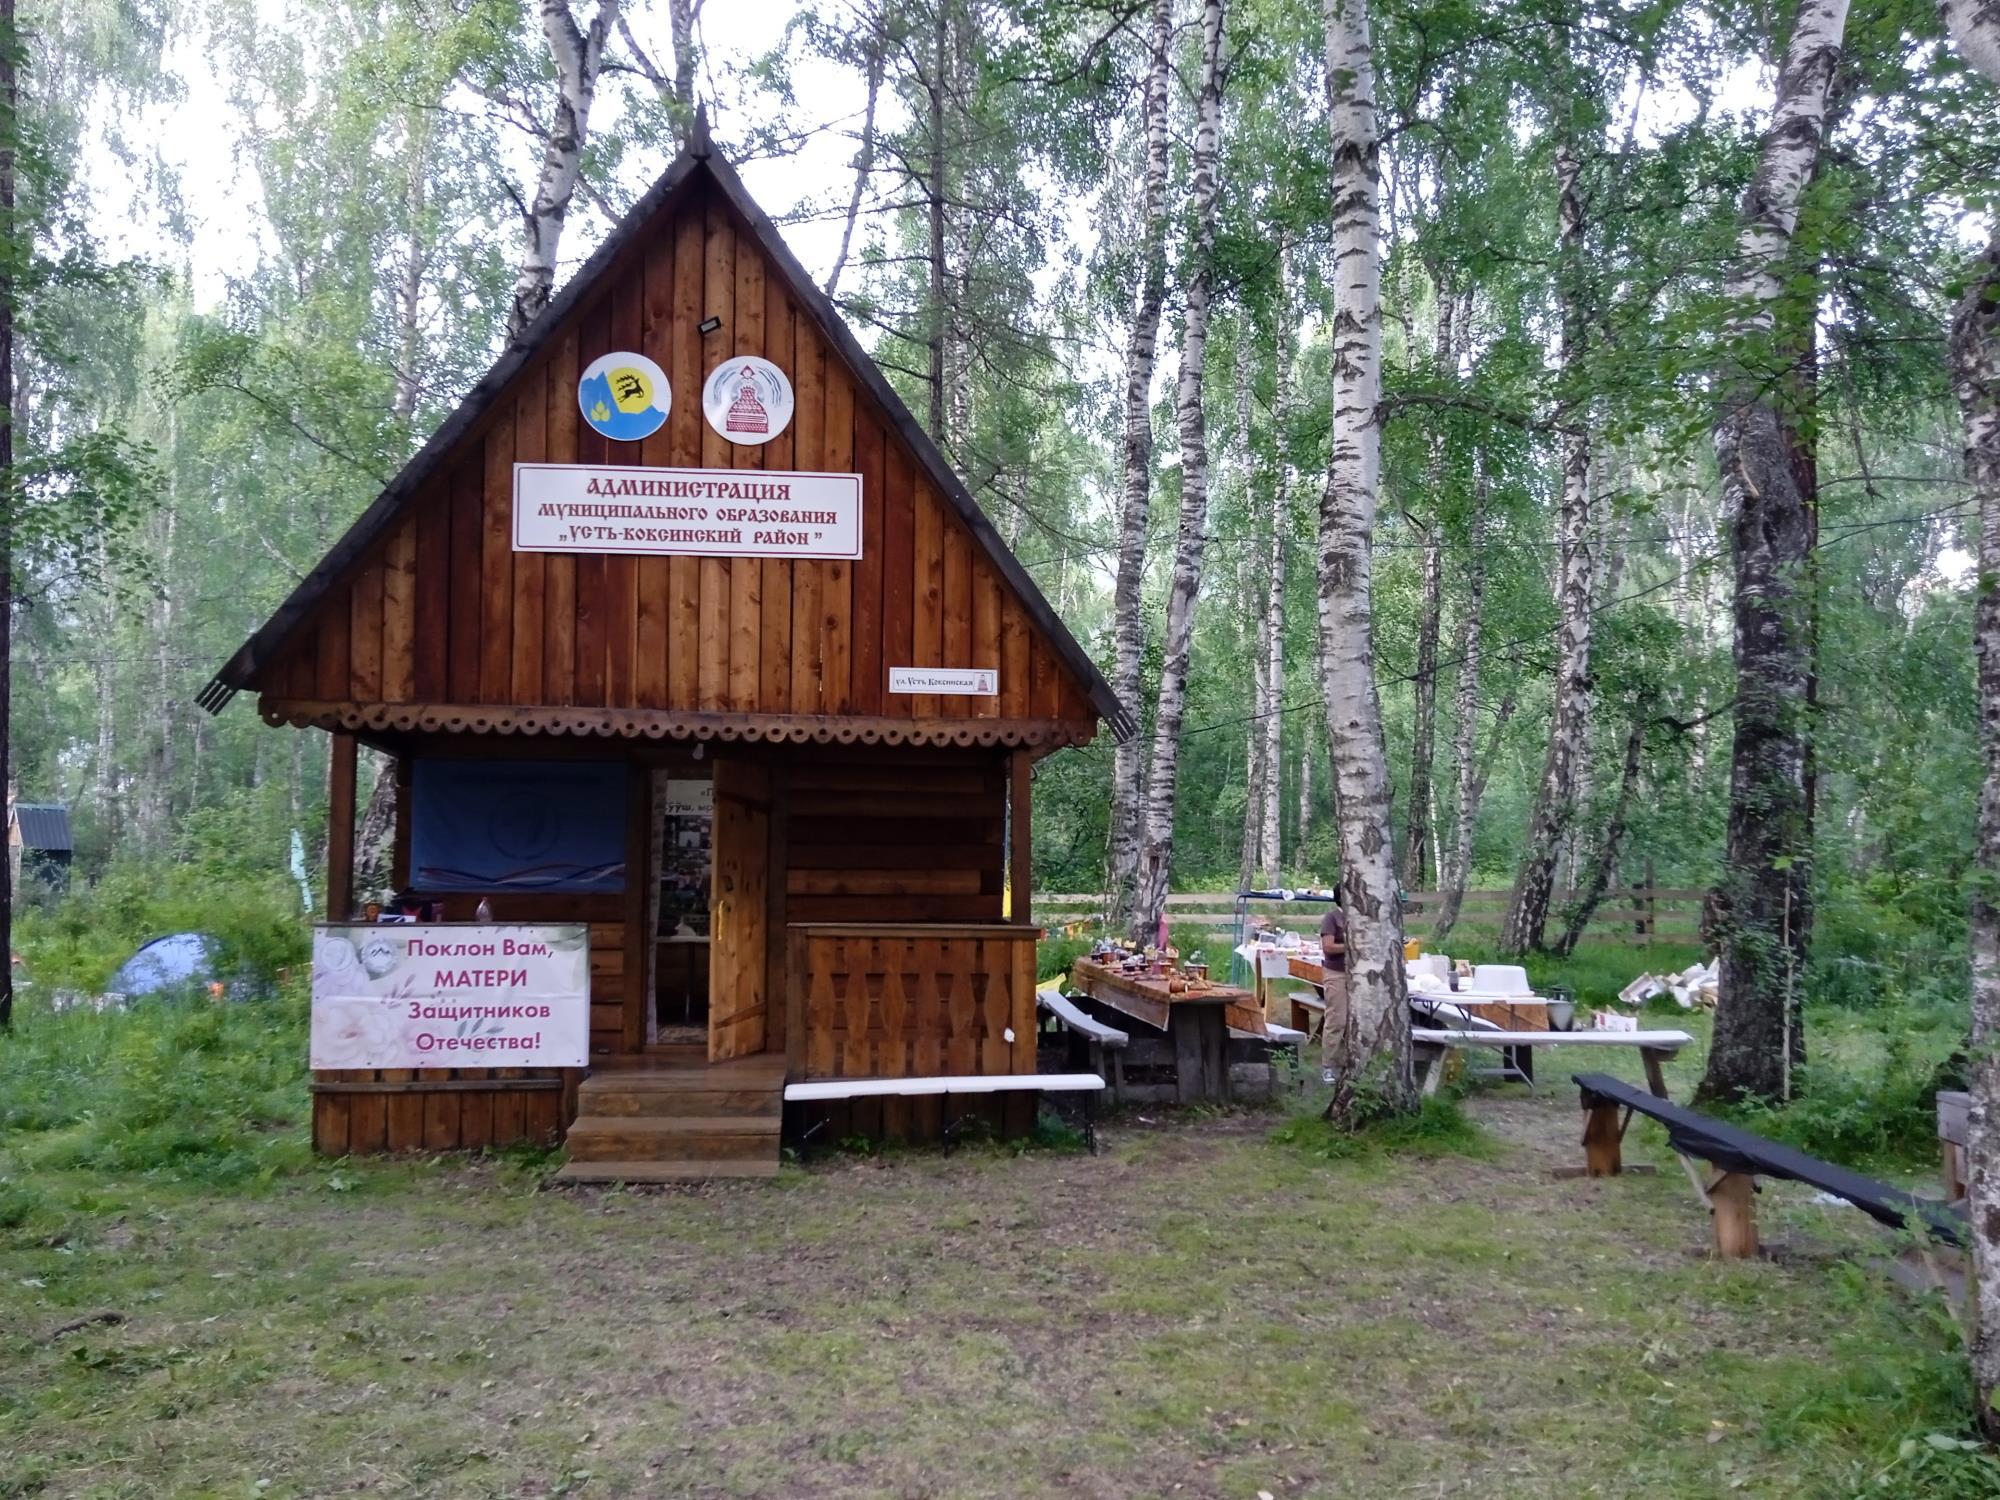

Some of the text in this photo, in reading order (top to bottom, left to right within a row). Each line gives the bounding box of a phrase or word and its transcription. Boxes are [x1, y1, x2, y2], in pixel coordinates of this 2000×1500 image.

[586, 477, 791, 503] АДМИНИСТРАЦИЯ
[537, 503, 838, 525] МУНИЦИПАЛЬНОГО ОБРАЗОВАНИЯ
[407, 938, 554, 959] Поклон Вам,
[433, 969, 527, 988] МАТЕРИ
[407, 1002, 551, 1021] Защитников
[416, 1032, 541, 1051] Отечества!
